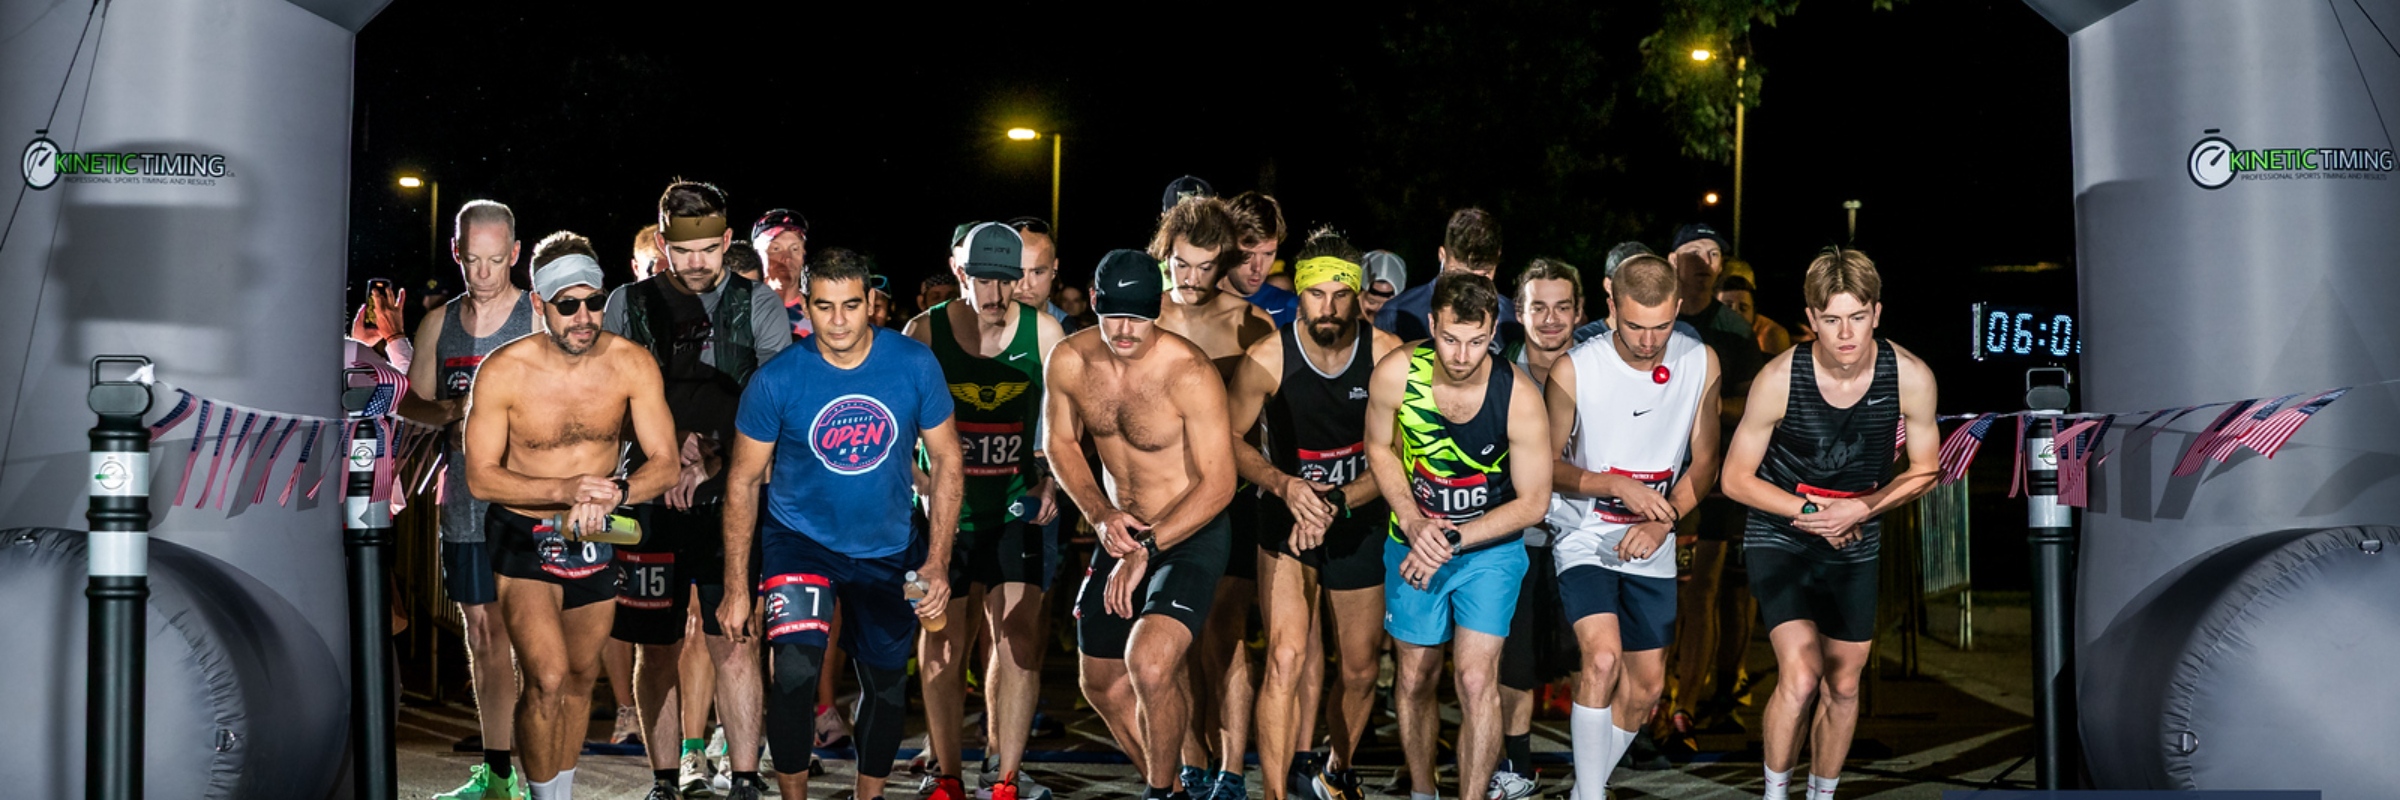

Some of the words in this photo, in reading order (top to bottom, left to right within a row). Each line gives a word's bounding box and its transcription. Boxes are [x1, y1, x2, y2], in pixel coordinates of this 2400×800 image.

[55, 153, 139, 175] KINETIC
[140, 153, 226, 177] TIMING
[2229, 149, 2318, 171] KINETIC
[2319, 149, 2394, 172] TIMING
[142, 177, 168, 185] TIMING
[187, 178, 216, 187] RESULTS
[2240, 173, 2293, 181] PROFESSIONAL
[2322, 172, 2347, 180] TIMING
[2364, 173, 2388, 181] RESULTS
[1987, 311, 2081, 356] 06:0
[821, 420, 886, 450] OPEN
[979, 435, 1022, 464] 132
[1438, 486, 1488, 512] 106
[636, 566, 665, 597] 15
[805, 586, 820, 617] 7
